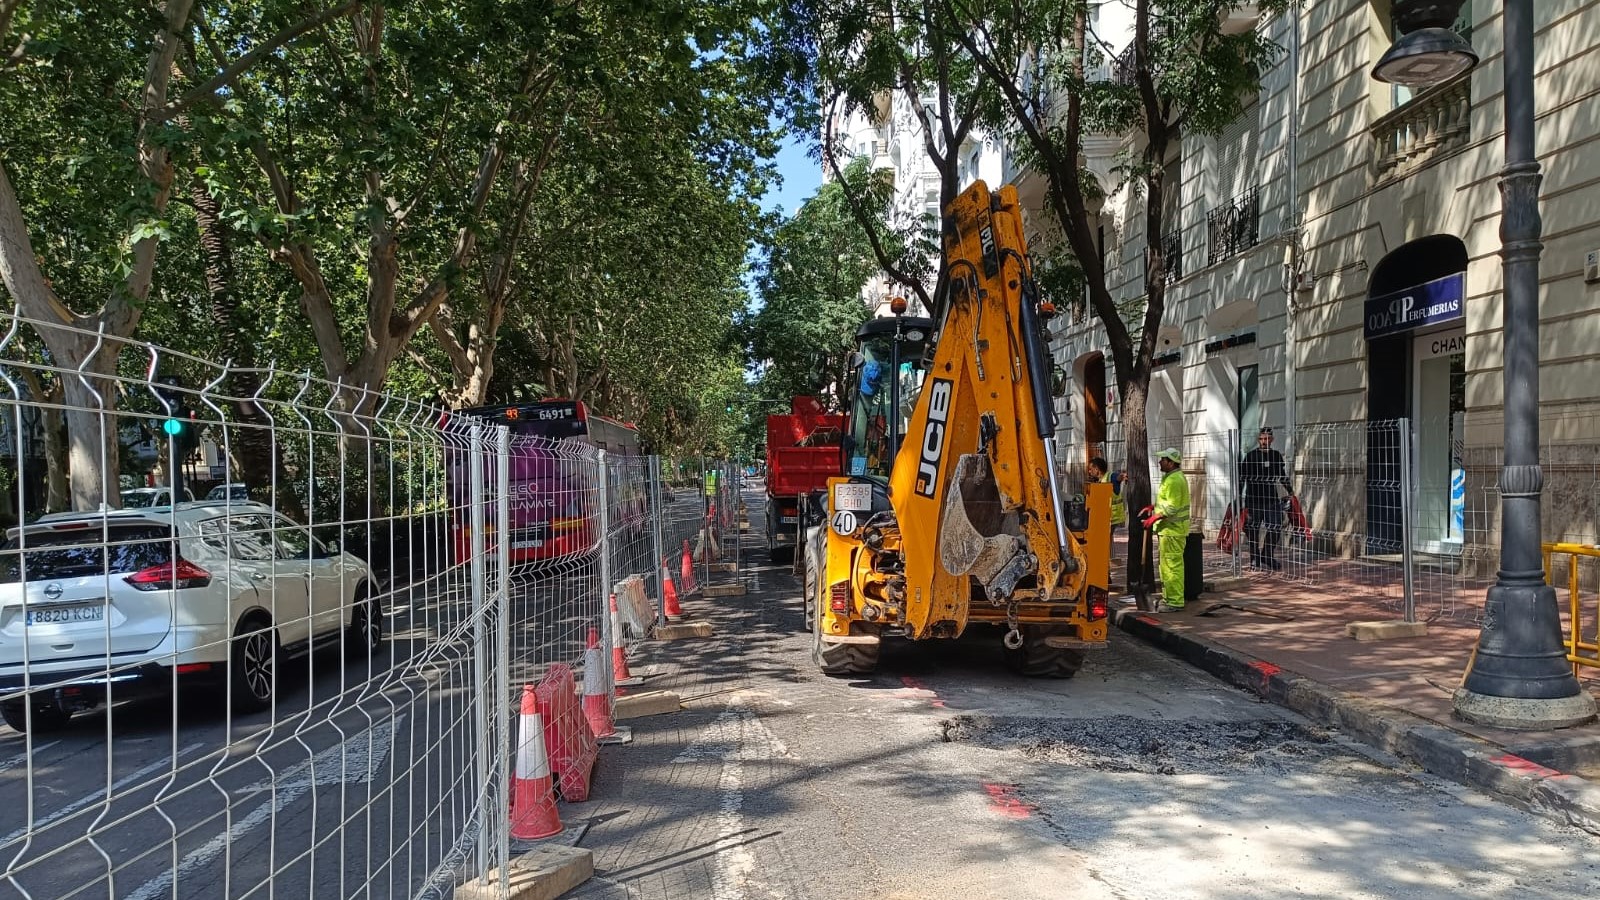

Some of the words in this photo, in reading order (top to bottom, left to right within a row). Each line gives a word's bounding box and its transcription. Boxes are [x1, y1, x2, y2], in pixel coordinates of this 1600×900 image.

[1401, 296, 1458, 321] PERFUMERIAS
[506, 408, 518, 419] 93
[539, 409, 565, 420] 6491
[920, 382, 951, 496] JCB
[846, 486, 870, 497] 2595
[843, 498, 862, 508] BHD
[833, 513, 853, 533] 40
[35, 609, 69, 622] 8820
[74, 607, 101, 620] KCN
